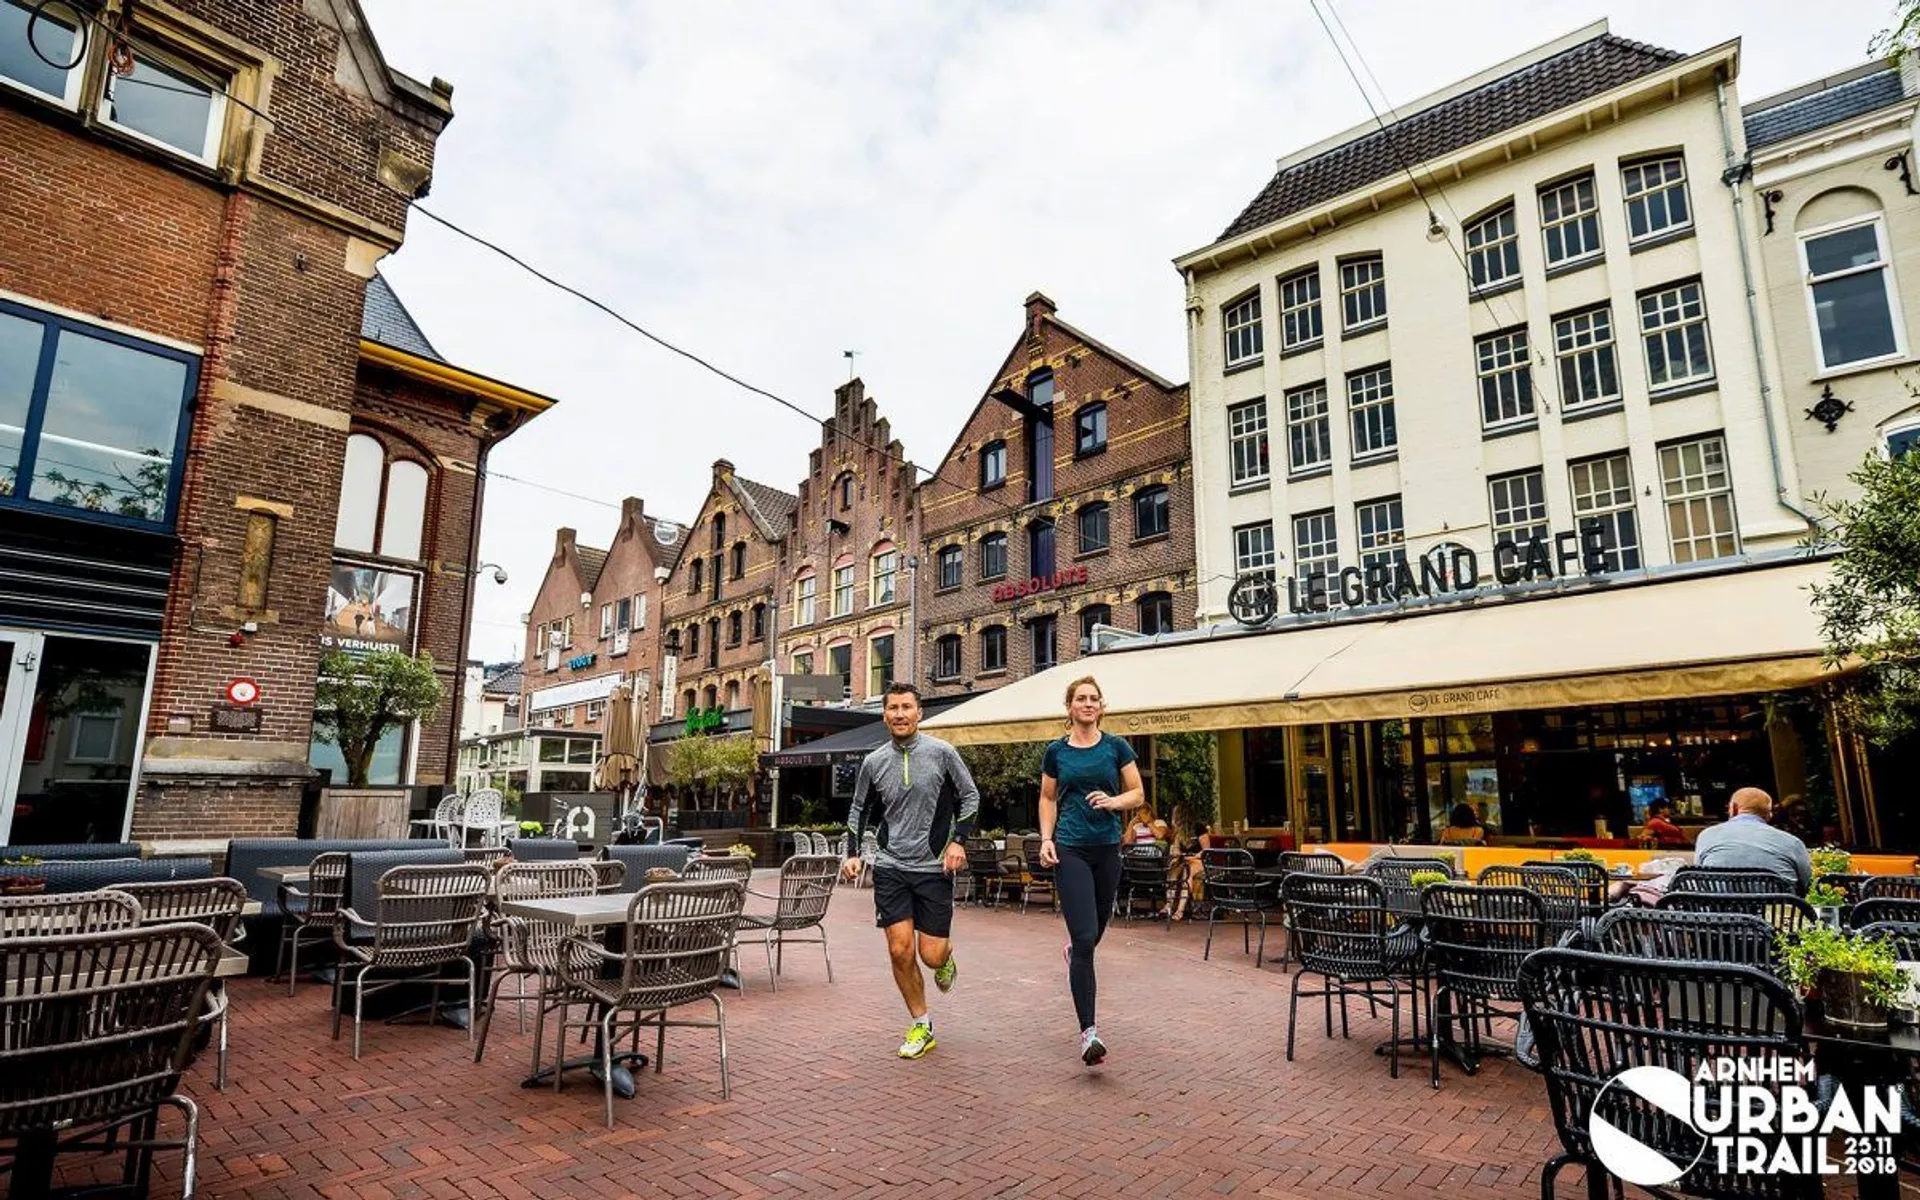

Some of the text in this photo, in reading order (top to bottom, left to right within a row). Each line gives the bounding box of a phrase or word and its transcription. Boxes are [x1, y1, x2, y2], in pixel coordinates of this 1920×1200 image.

[991, 564, 1087, 603] ABSOLUTE
[1287, 516, 1606, 615] LE GRAND CAFÉ
[1443, 691, 1475, 704] GRAND
